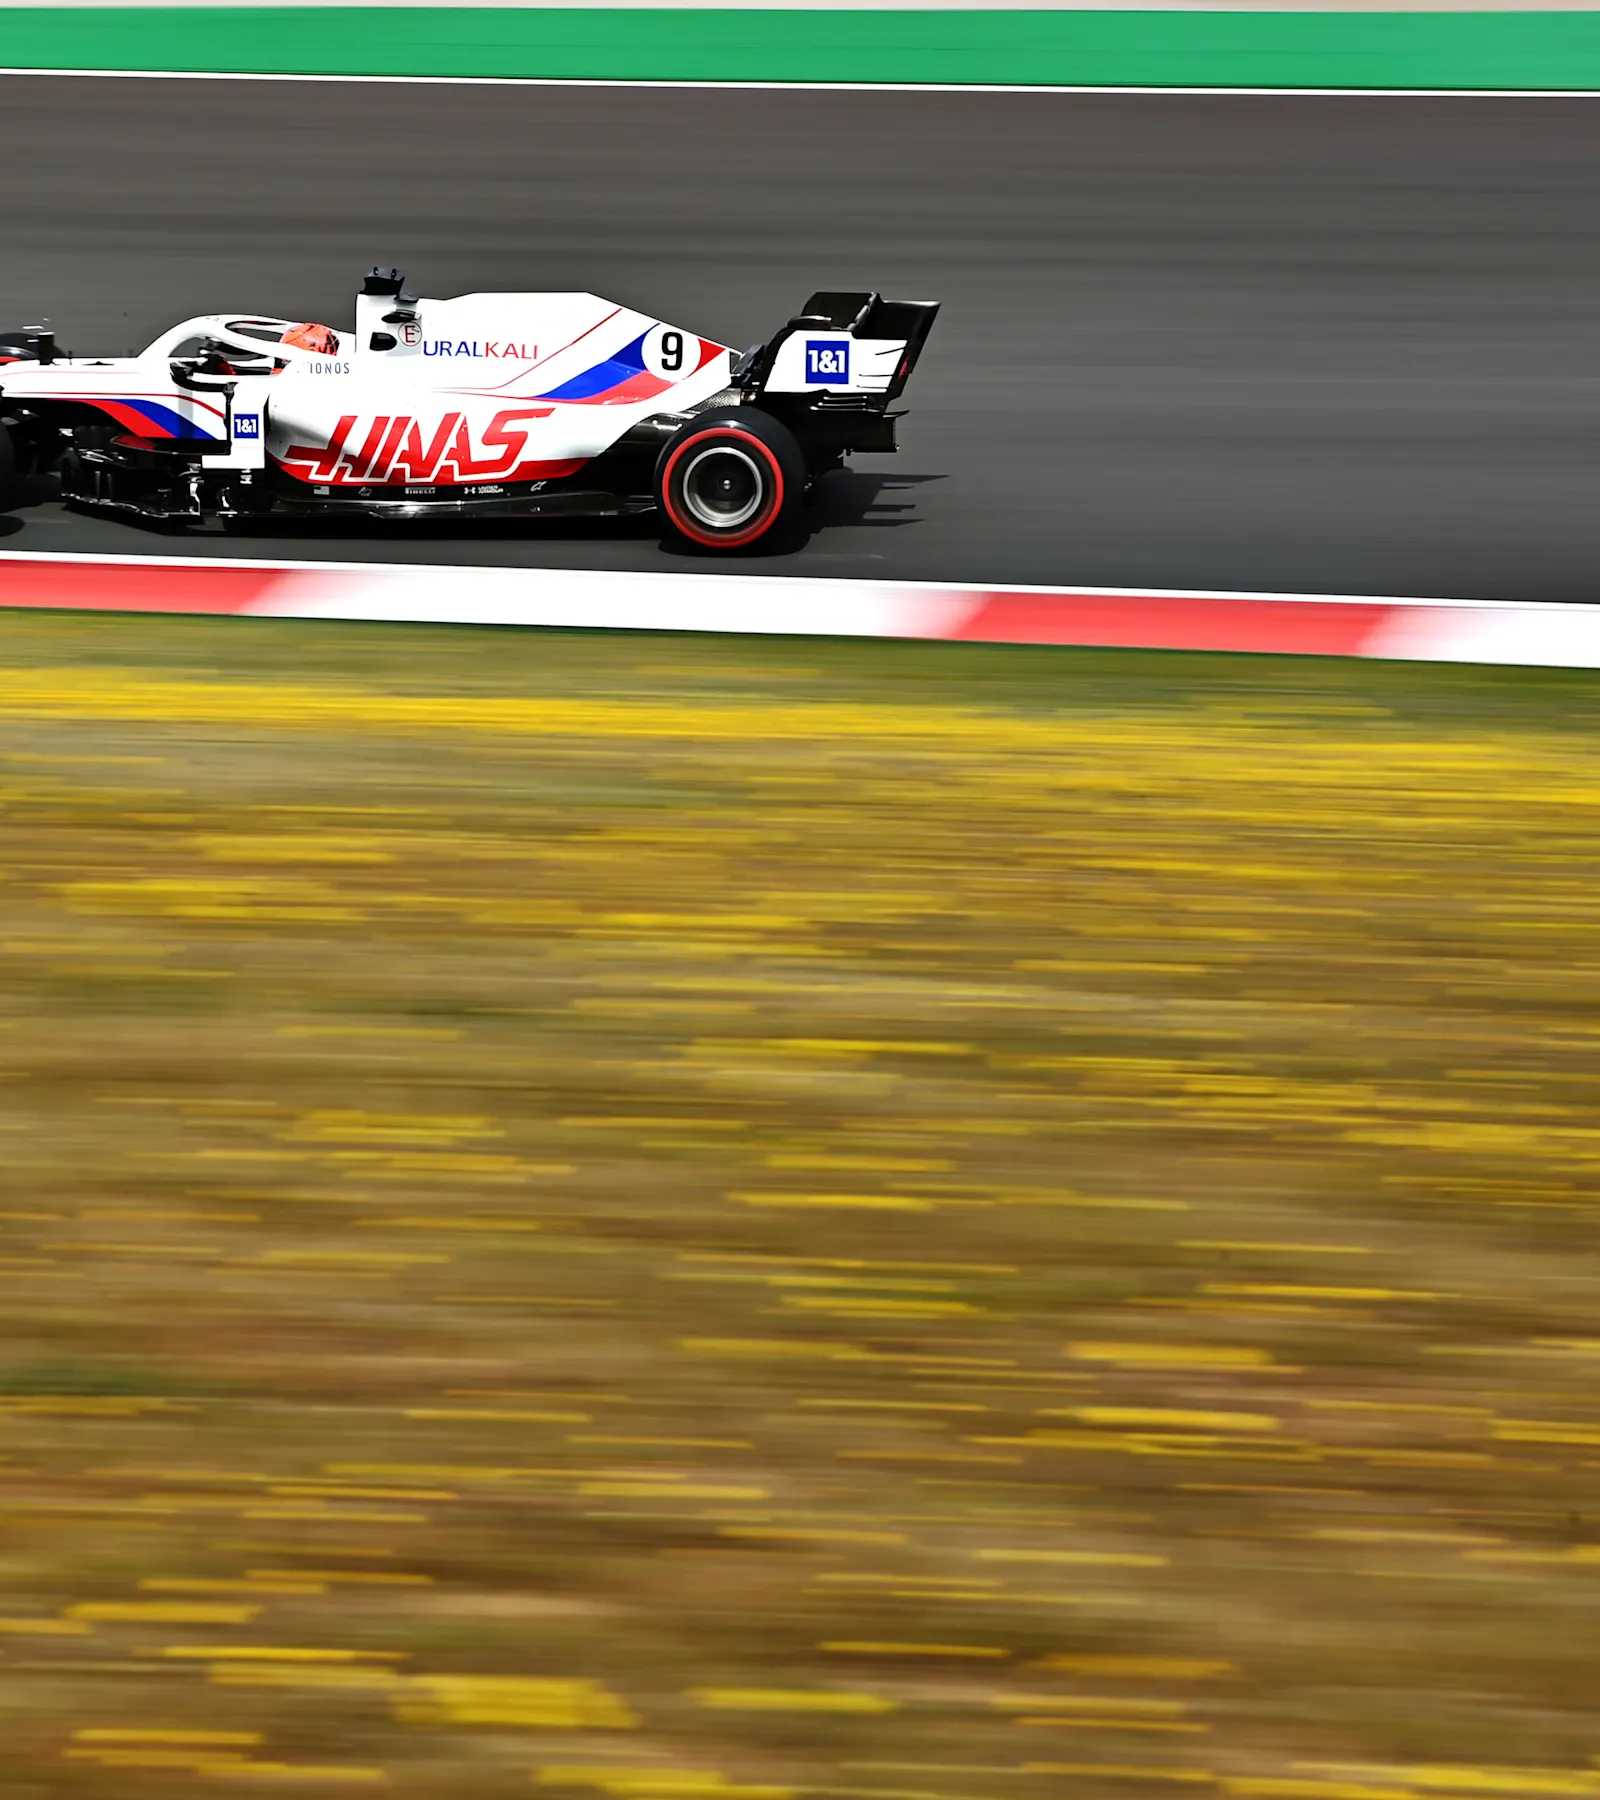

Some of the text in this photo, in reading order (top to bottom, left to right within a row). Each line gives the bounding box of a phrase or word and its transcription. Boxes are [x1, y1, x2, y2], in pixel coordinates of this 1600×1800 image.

[423, 340, 538, 359] URALKALI
[661, 331, 684, 371] 9
[309, 362, 350, 374] IONOS
[808, 350, 846, 373] 1&1
[235, 418, 257, 433] 1&1
[284, 408, 555, 479] HAAS
